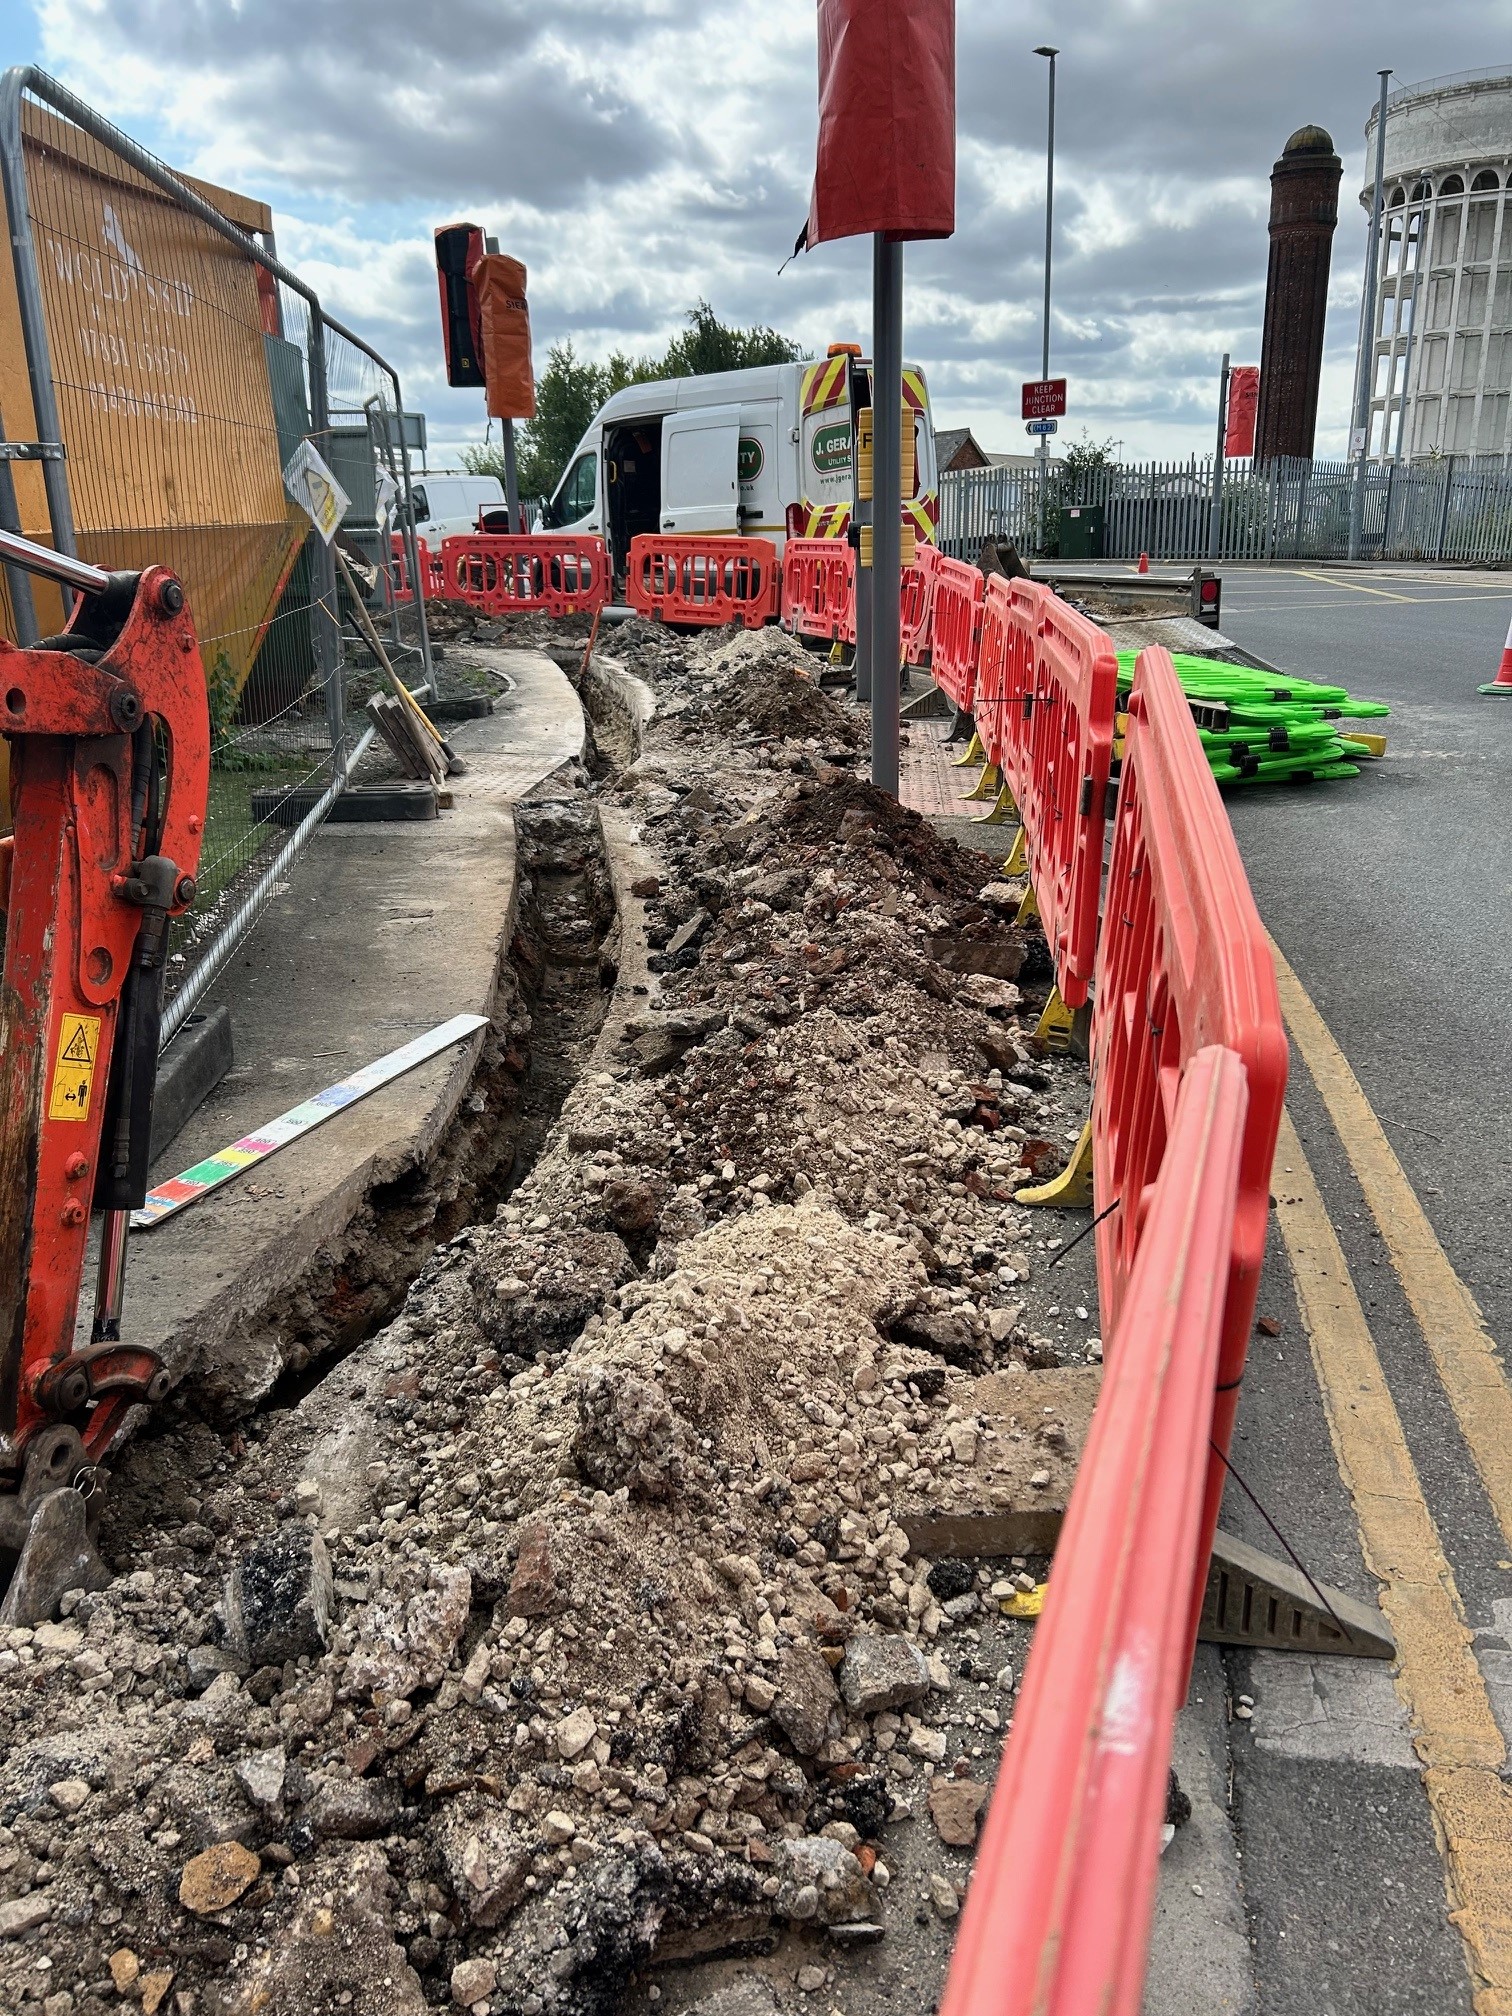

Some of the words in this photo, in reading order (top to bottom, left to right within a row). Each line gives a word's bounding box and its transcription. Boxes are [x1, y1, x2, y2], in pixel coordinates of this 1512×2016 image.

[48, 239, 129, 302] WOLD
[1034, 384, 1053, 394] KEEP
[1025, 393, 1063, 405] JUNCTION
[1032, 404, 1055, 414] CLEAR
[816, 442, 824, 455] J.
